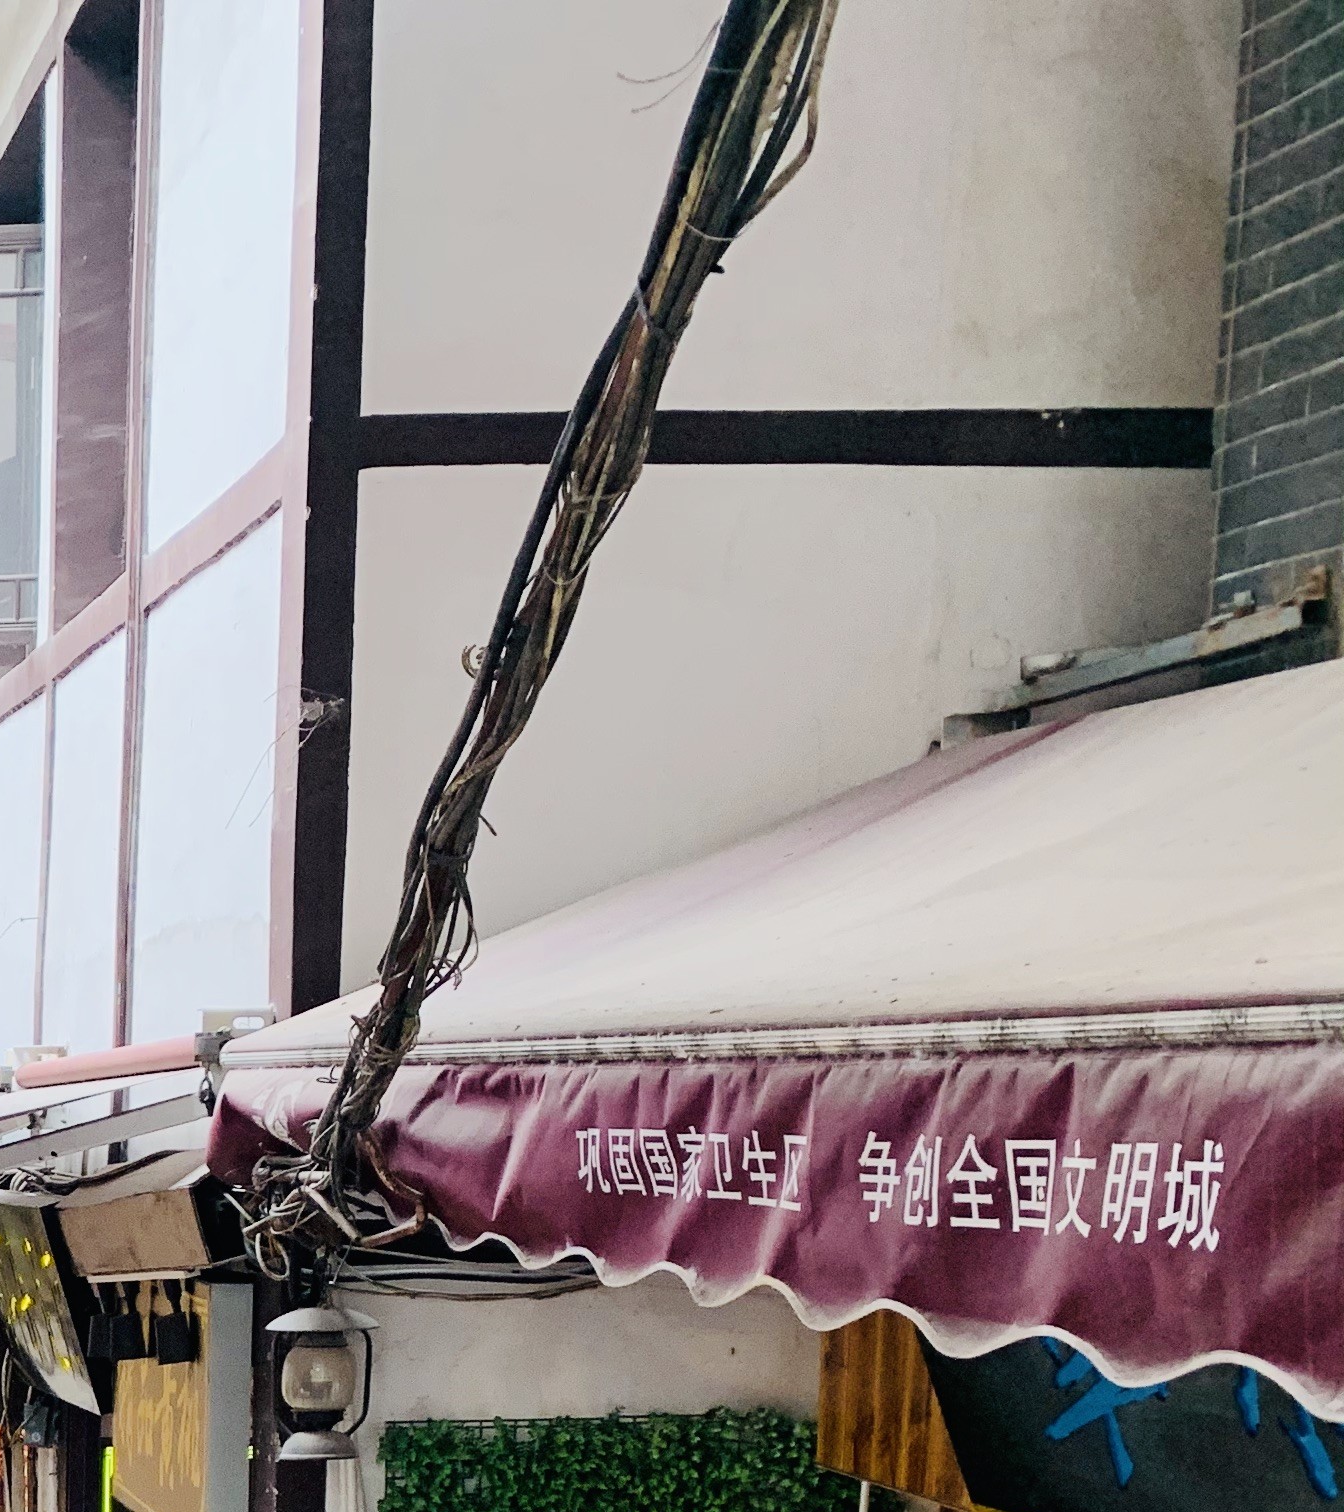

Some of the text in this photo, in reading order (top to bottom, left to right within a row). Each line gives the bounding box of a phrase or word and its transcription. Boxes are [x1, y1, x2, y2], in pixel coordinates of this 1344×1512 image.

[857, 1131, 1226, 1252] 争创全国文明城
